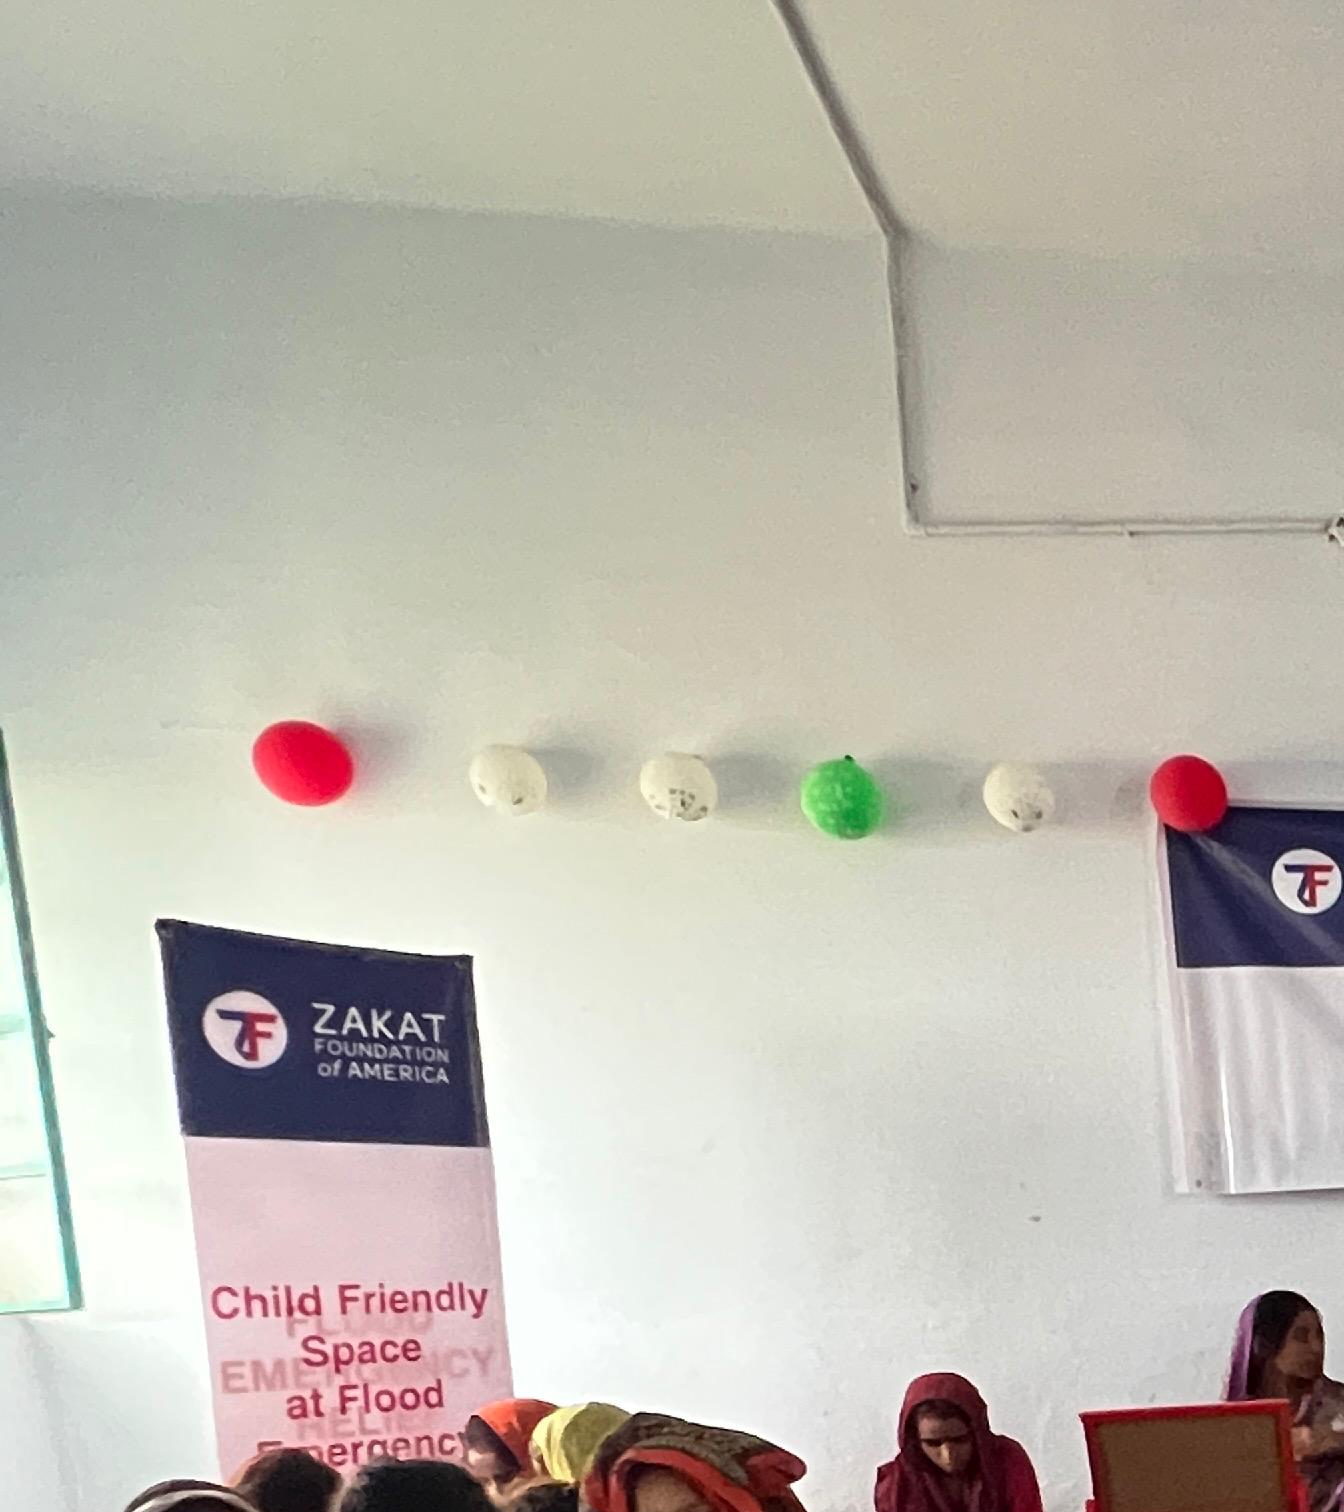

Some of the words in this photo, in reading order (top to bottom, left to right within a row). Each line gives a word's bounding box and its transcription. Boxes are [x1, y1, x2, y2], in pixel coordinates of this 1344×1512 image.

[311, 1002, 446, 1043] ZAKAT
[314, 1038, 450, 1064] FOUNDATION
[317, 1059, 343, 1079] of
[347, 1061, 450, 1084] AMERICA
[210, 1283, 322, 1321] Child
[336, 1281, 489, 1320] Friendly
[301, 1333, 422, 1374] Space
[287, 1389, 324, 1421] at
[337, 1378, 444, 1416] Flood
